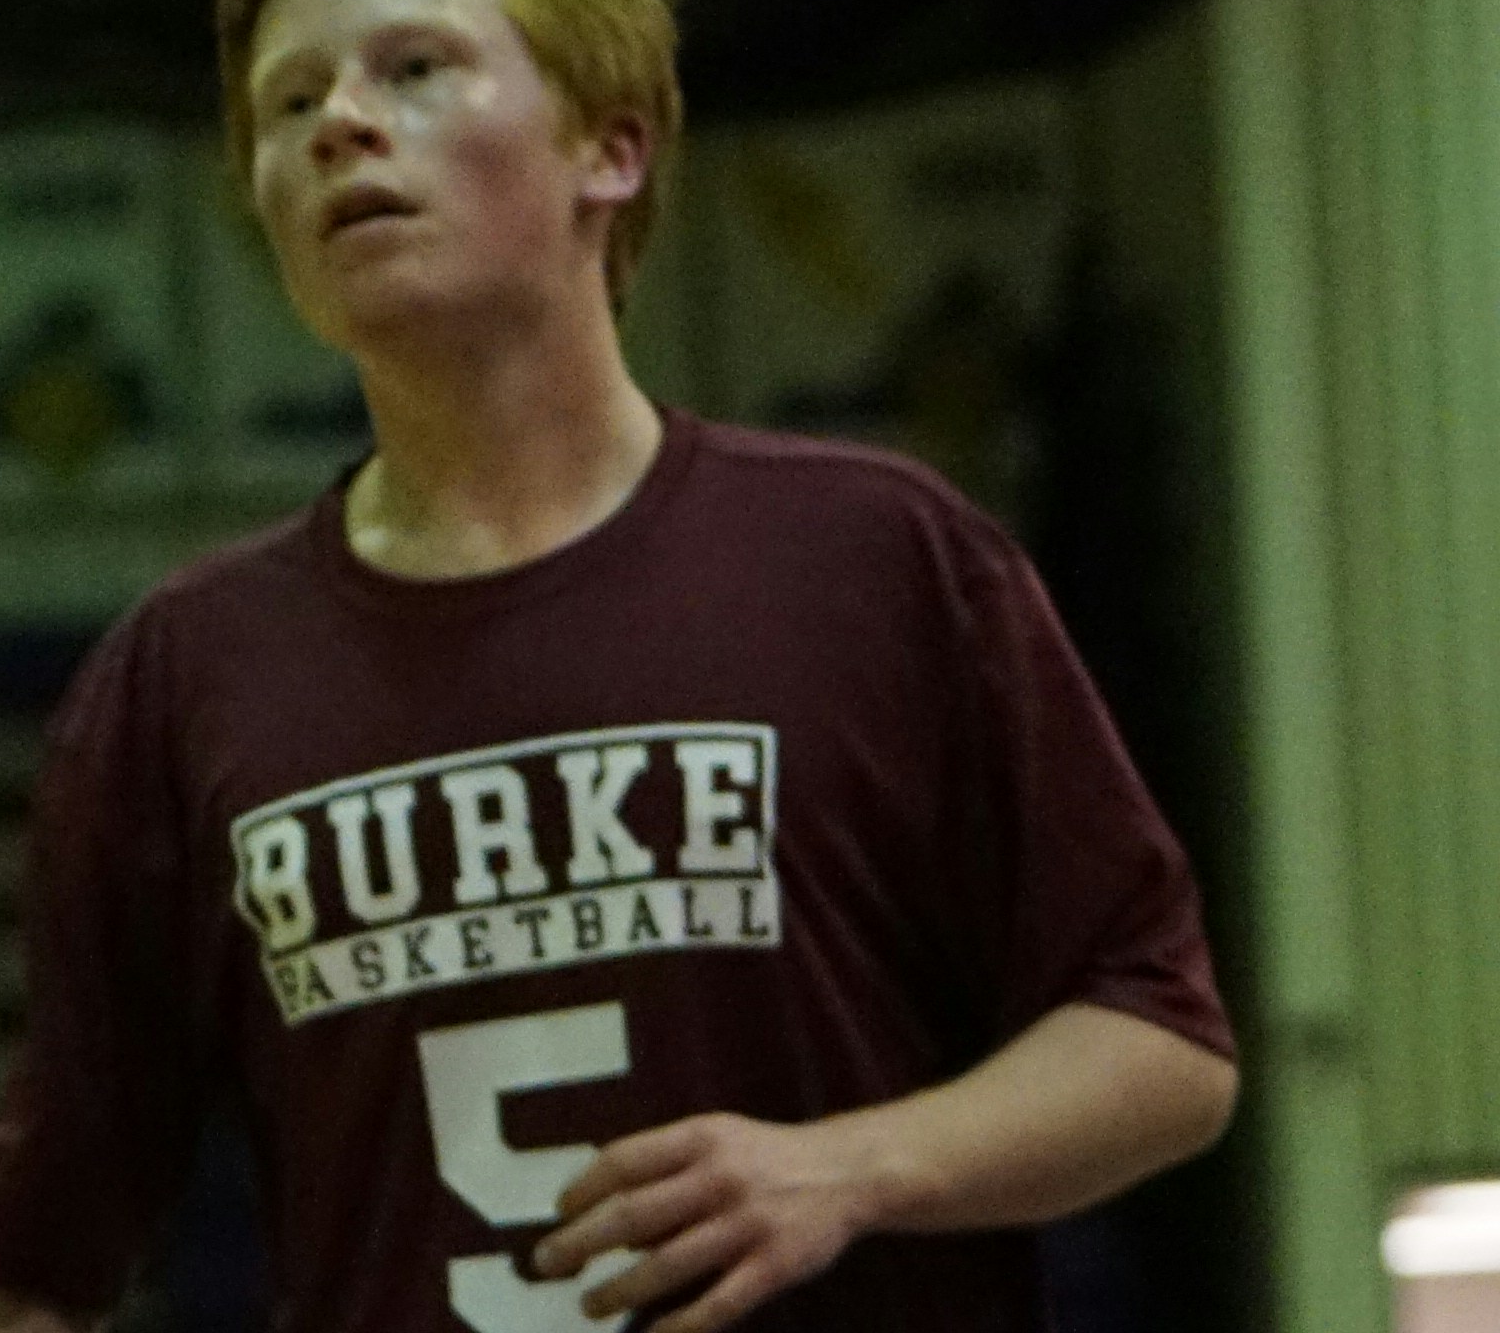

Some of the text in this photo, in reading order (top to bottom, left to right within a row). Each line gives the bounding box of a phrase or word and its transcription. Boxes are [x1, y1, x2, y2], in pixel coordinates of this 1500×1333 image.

[244, 739, 761, 947] BURKE
[272, 886, 770, 1017] BASKETBALL
[416, 999, 645, 1333] 5
